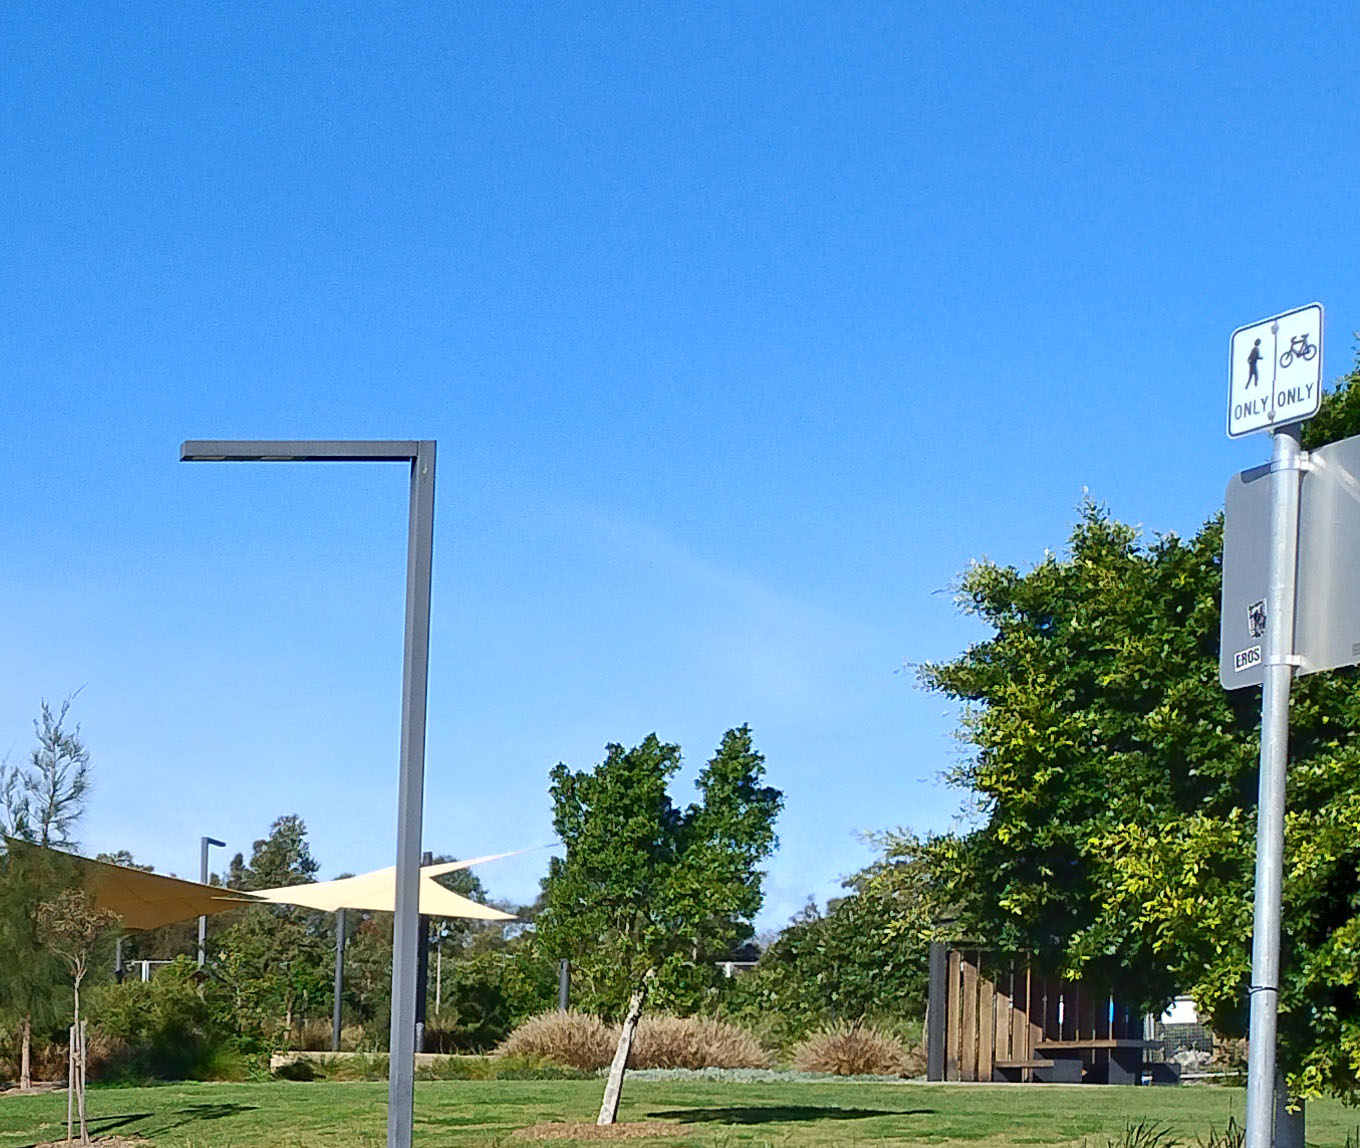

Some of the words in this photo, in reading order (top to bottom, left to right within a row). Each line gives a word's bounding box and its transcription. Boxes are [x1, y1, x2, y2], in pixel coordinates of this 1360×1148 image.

[1234, 395, 1269, 420] ONLY
[1278, 382, 1314, 408] ONLY
[1236, 648, 1260, 669] EROS
